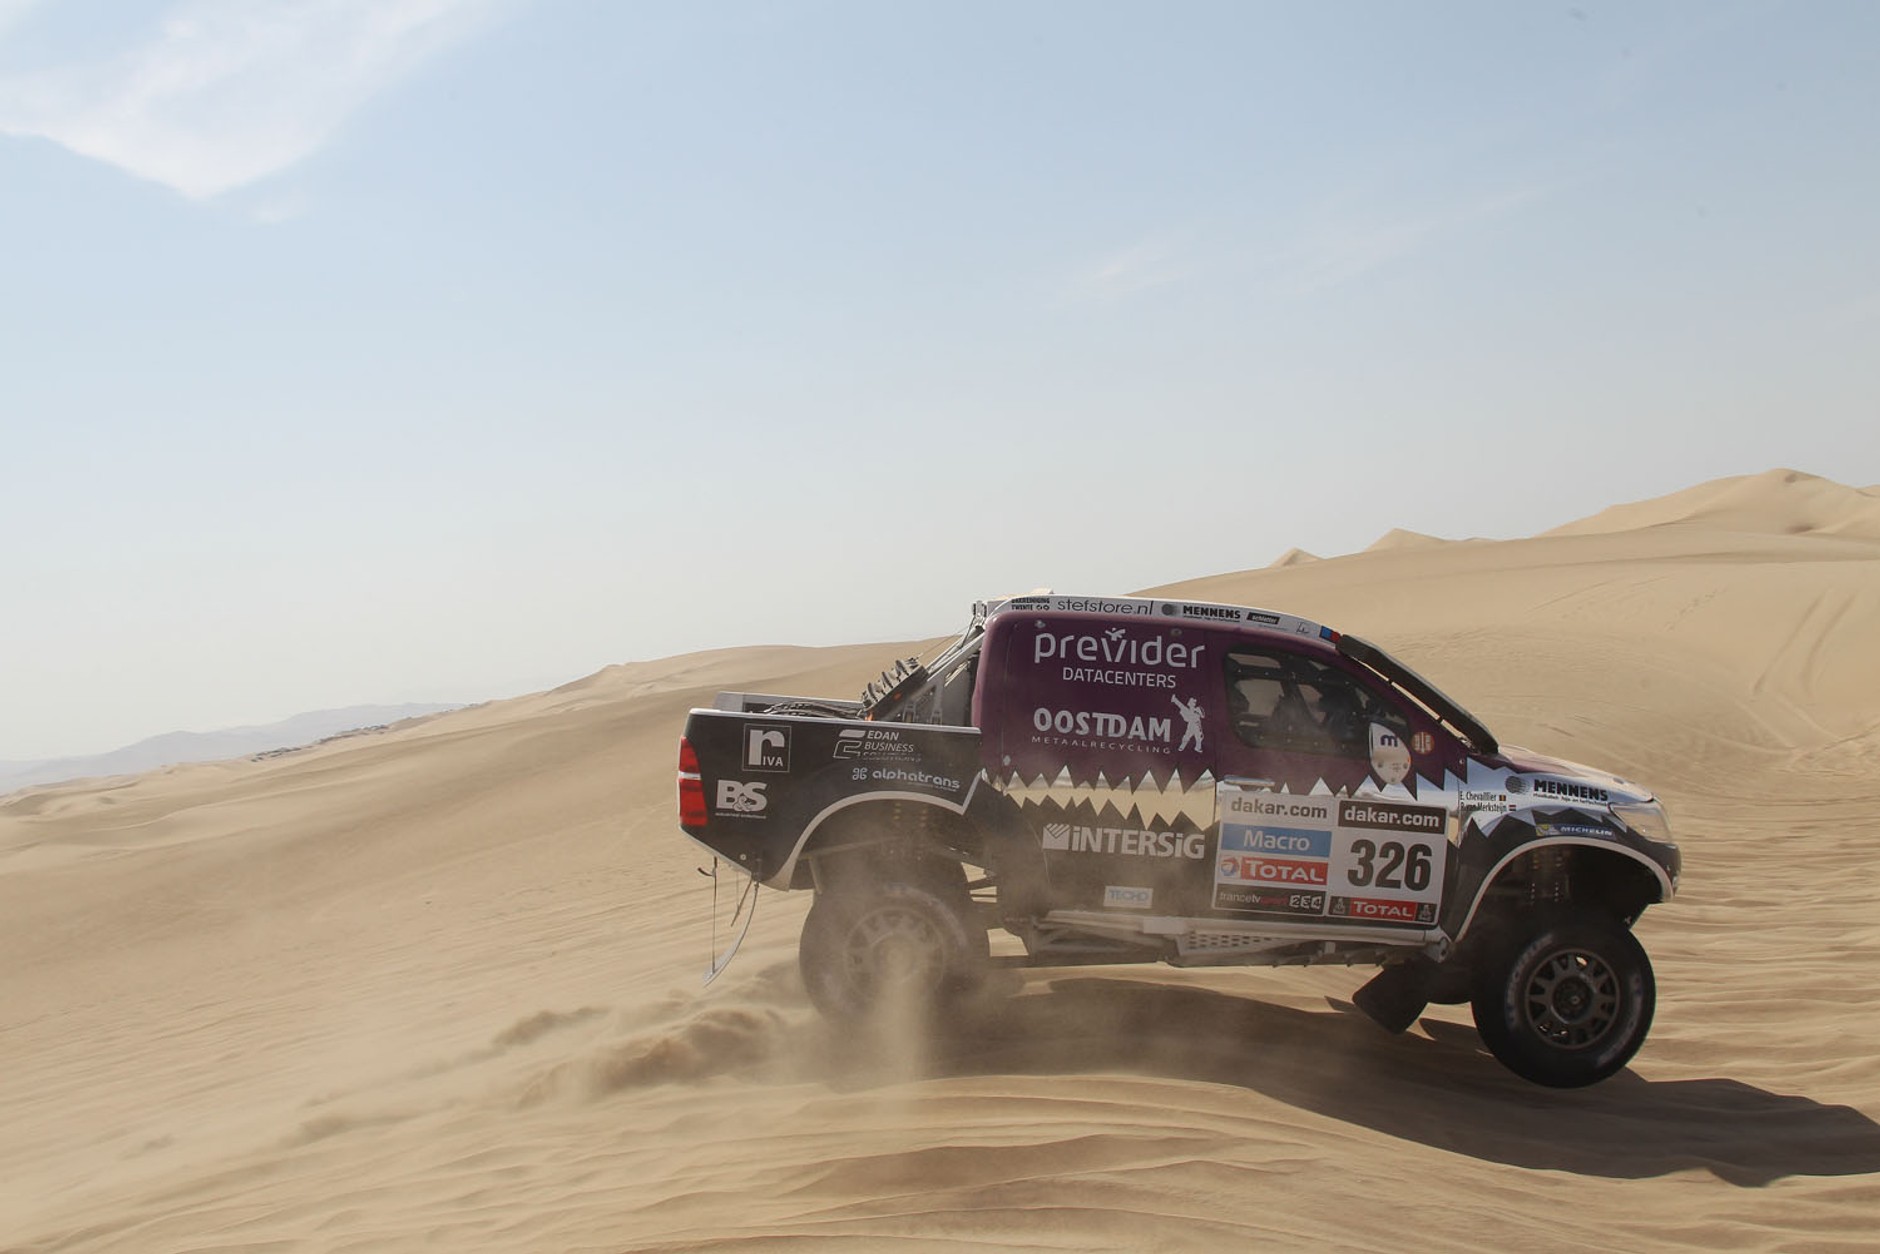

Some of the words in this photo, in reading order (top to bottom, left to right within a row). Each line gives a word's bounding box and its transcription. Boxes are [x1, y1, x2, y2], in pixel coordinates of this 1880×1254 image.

[1057, 599, 1154, 615] stefstore.nl
[1183, 605, 1240, 619] MENNENS
[1034, 633, 1206, 669] previder
[1062, 667, 1177, 688] DATACENTERS
[867, 730, 900, 740] EDAN
[1033, 707, 1171, 742] OOSTDAM
[864, 741, 914, 753] BUSINESS
[1032, 736, 1171, 754] METAALRECYCLING
[872, 768, 960, 789] alphatrans
[1534, 779, 1609, 801] MENNENS
[1231, 798, 1328, 819] dakar.com
[1345, 806, 1439, 827] dakar.com
[1244, 829, 1311, 851] Macro
[1560, 826, 1613, 836] MICHELIN
[1245, 860, 1325, 882] TOTAL
[1348, 839, 1432, 891] 326
[1353, 901, 1414, 917] TOTAL
